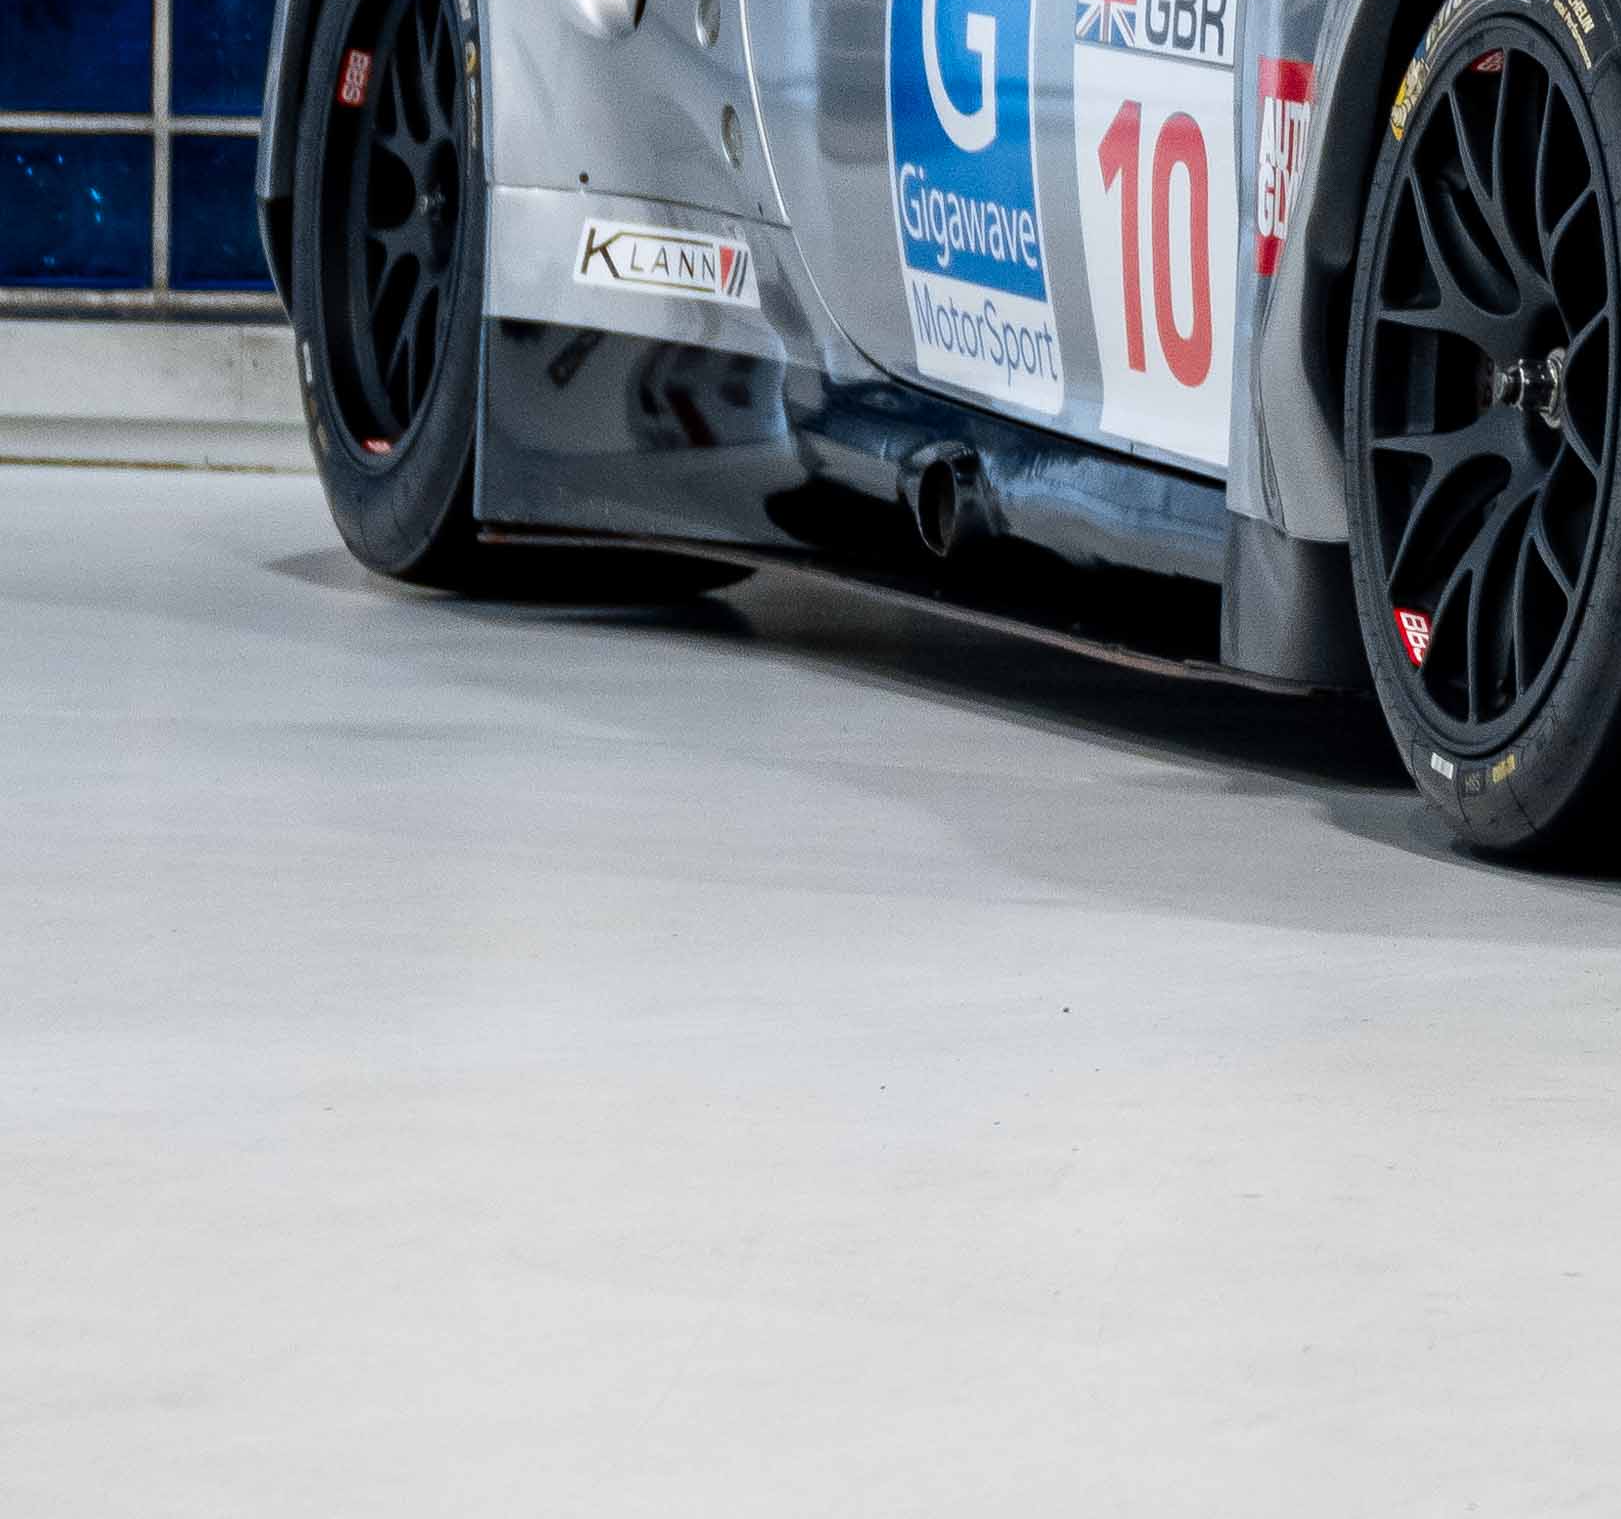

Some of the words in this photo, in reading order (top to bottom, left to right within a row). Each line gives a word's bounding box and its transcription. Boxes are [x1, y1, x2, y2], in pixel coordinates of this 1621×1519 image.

[580, 226, 716, 293] KLANN
[899, 162, 1038, 268] Gigawave
[1098, 99, 1213, 388] 10
[912, 280, 1058, 388] MotorSport
